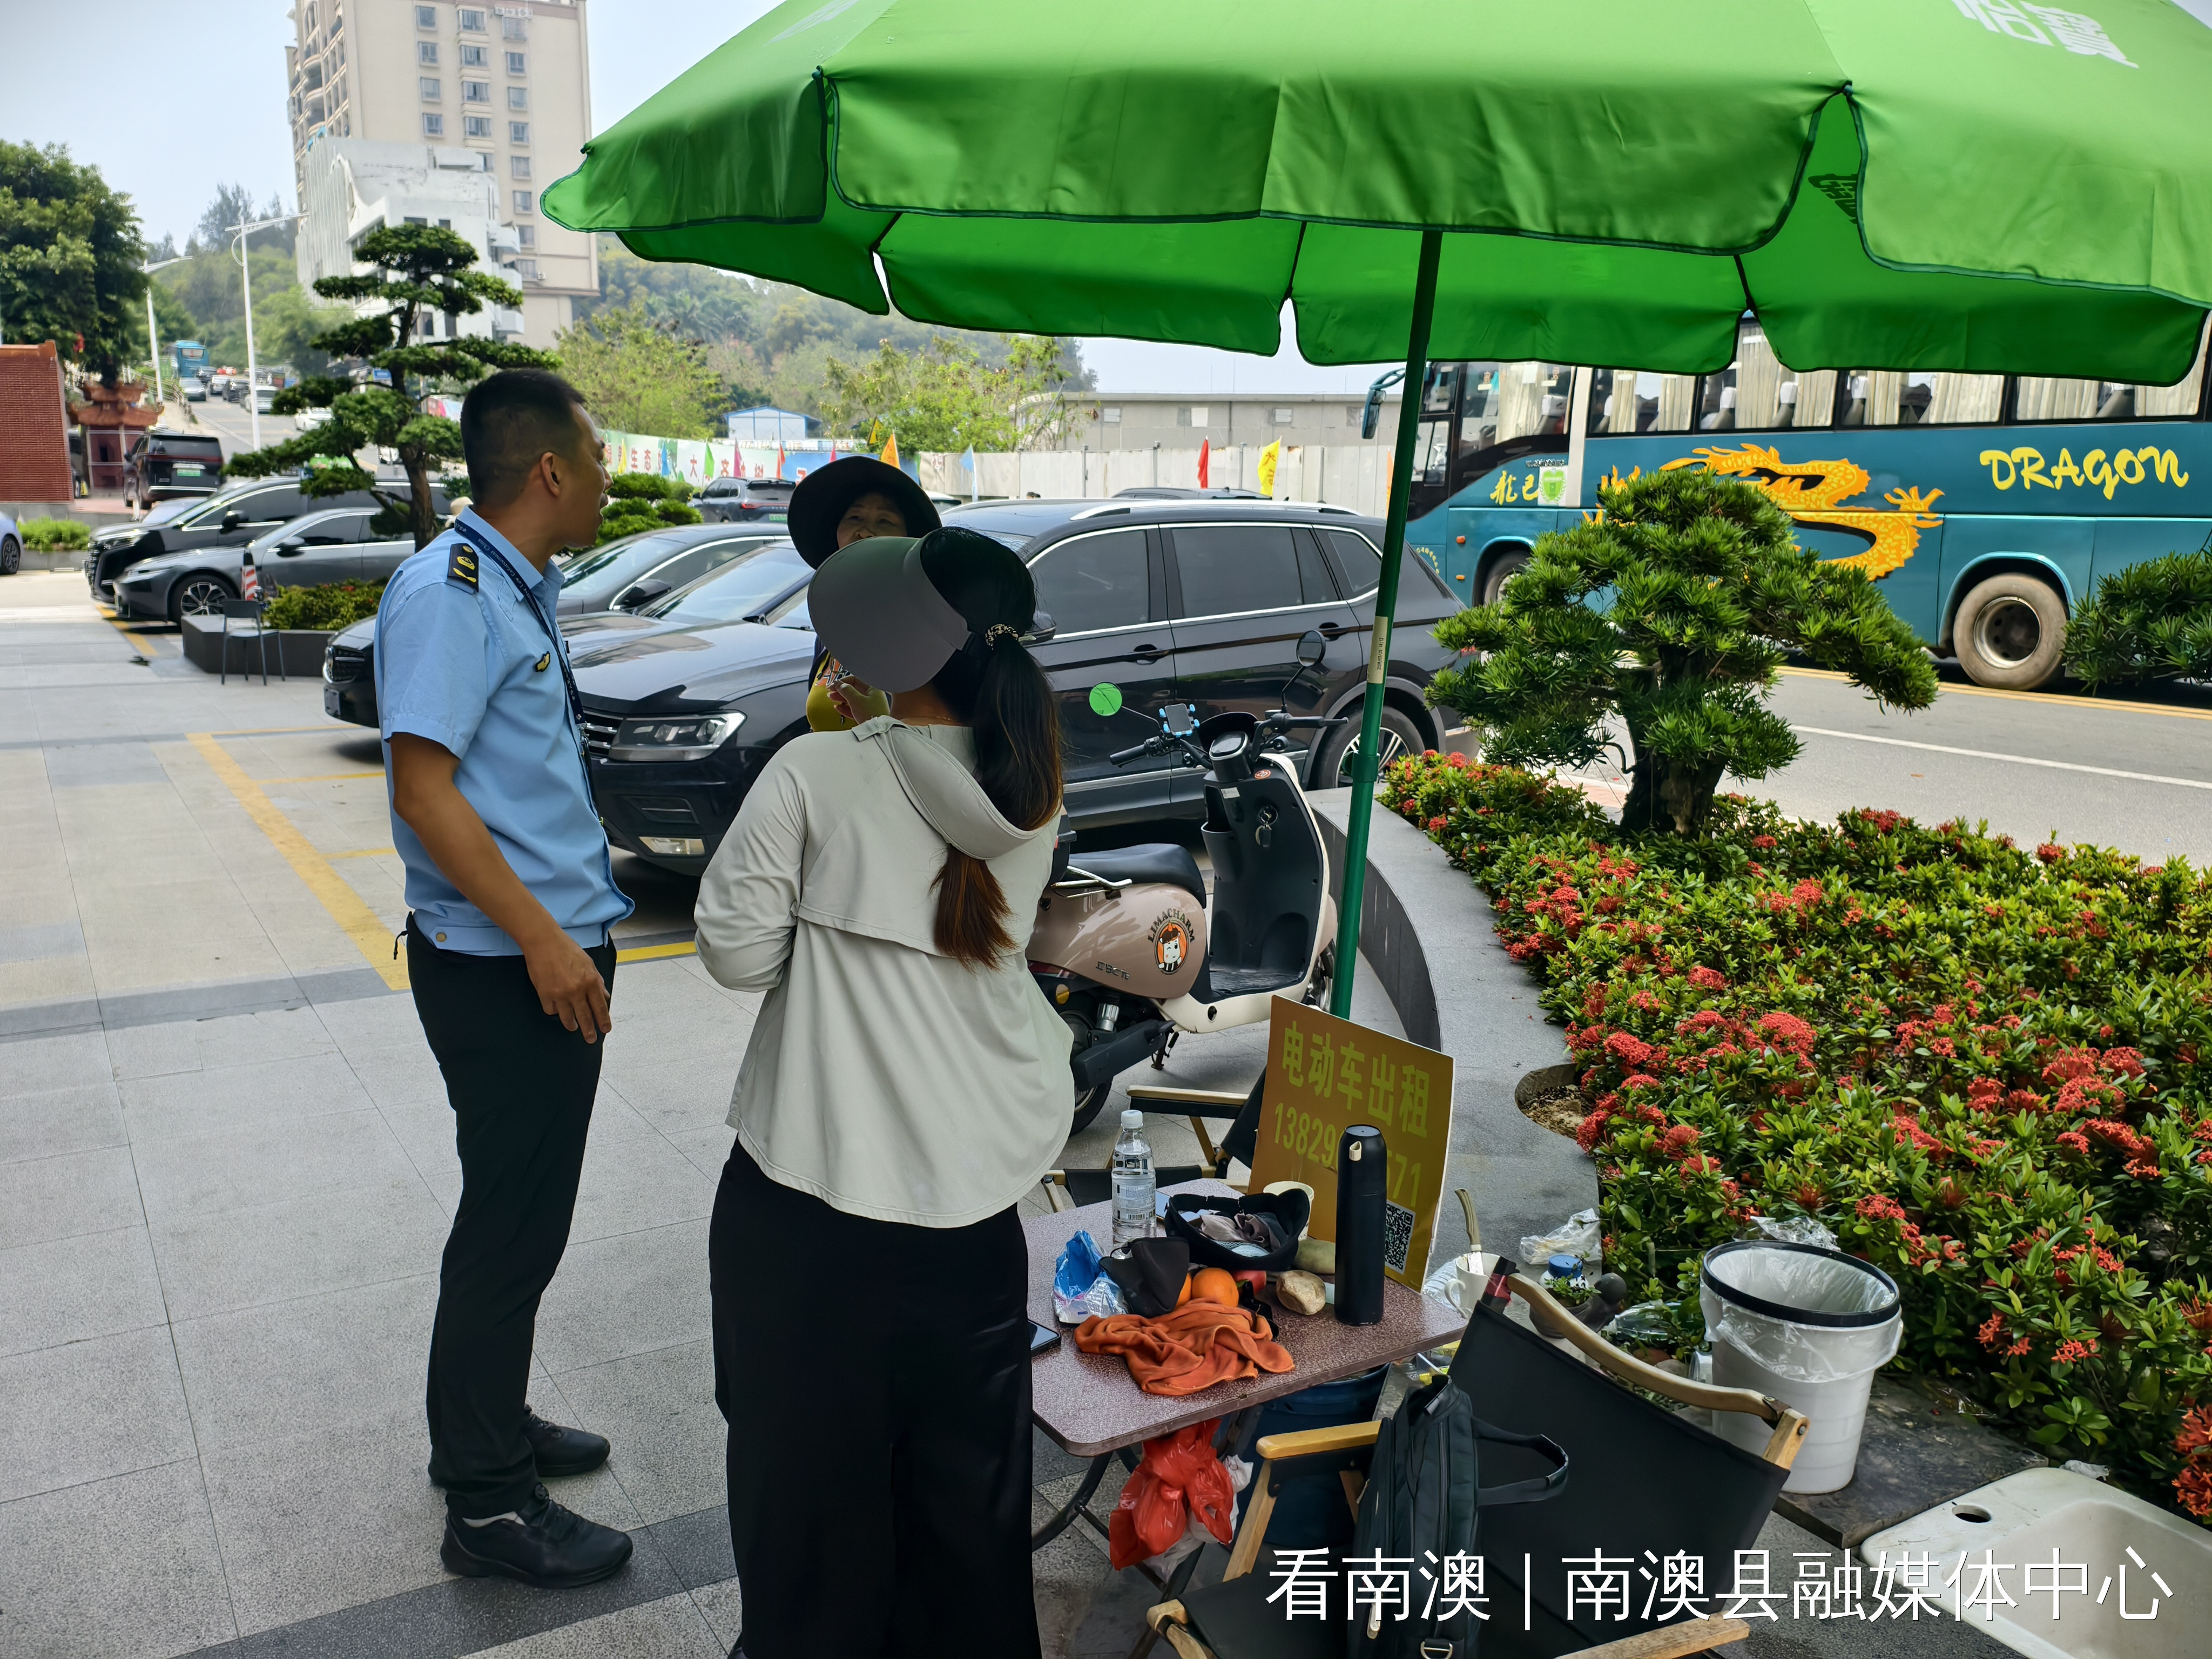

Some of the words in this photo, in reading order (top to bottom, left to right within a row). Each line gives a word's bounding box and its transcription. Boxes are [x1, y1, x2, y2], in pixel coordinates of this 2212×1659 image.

[1148, 908, 1195, 943] LIMACHARM
[1282, 1020, 1430, 1138] 电动车出租
[1274, 1102, 1421, 1208] 1382971
